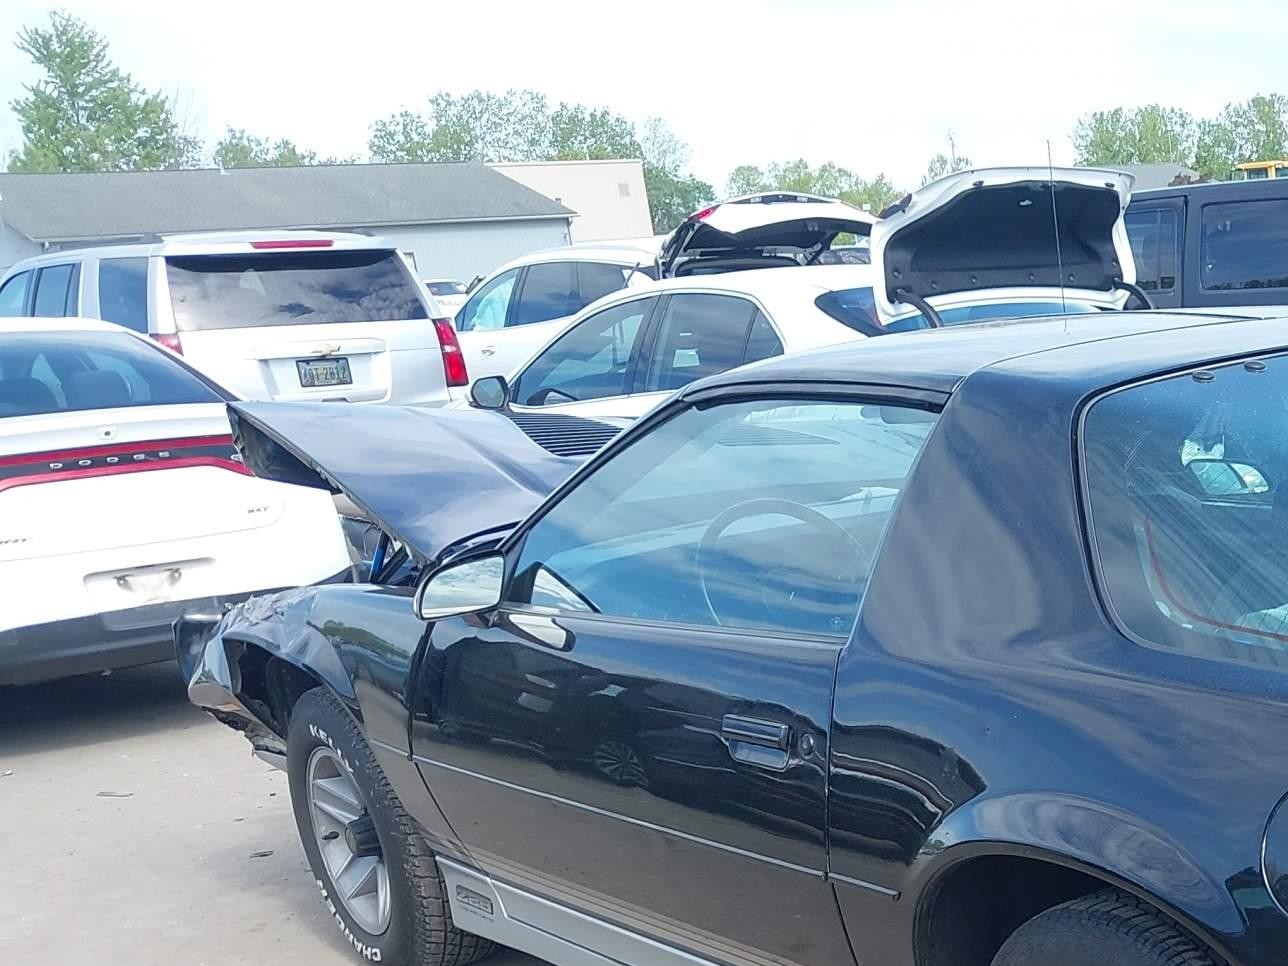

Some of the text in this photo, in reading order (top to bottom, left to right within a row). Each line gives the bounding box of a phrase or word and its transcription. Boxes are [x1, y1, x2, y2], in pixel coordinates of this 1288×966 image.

[49, 450, 170, 471] DODGE
[308, 723, 355, 775] KELLY
[314, 878, 382, 964] CHARGER
